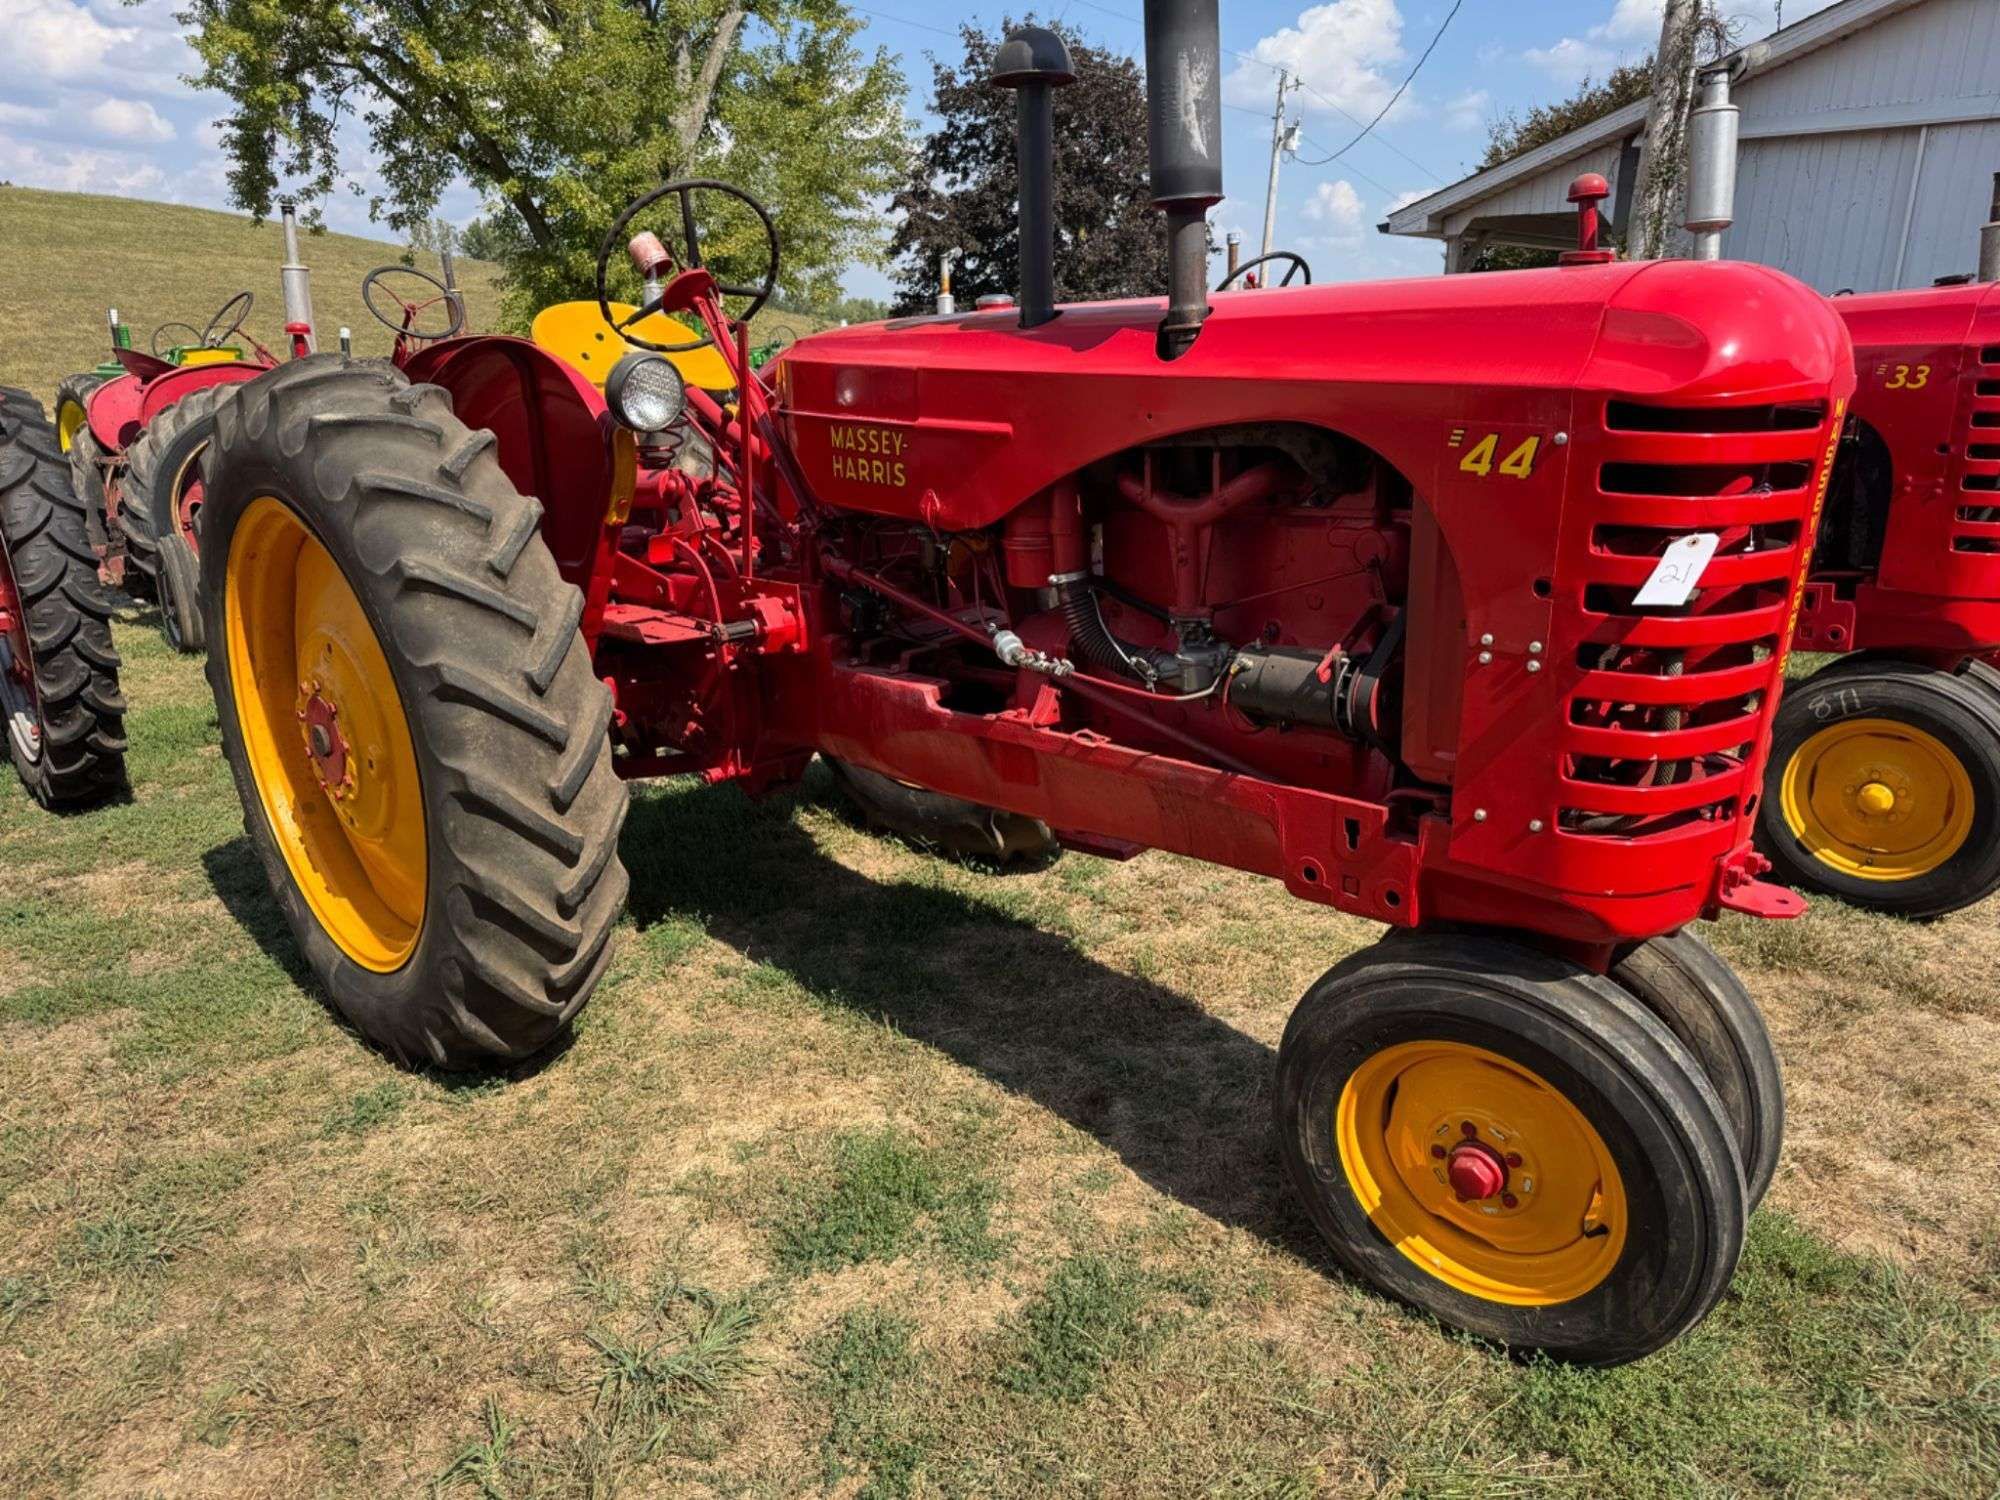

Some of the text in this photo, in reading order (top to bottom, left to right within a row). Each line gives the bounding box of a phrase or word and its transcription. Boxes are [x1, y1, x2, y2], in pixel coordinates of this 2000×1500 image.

[1885, 365, 1931, 389] 33
[830, 425, 908, 456] MASSEY-
[832, 455, 906, 487] HARRIS
[1460, 434, 1541, 479] 44
[1660, 562, 1693, 584] 21
